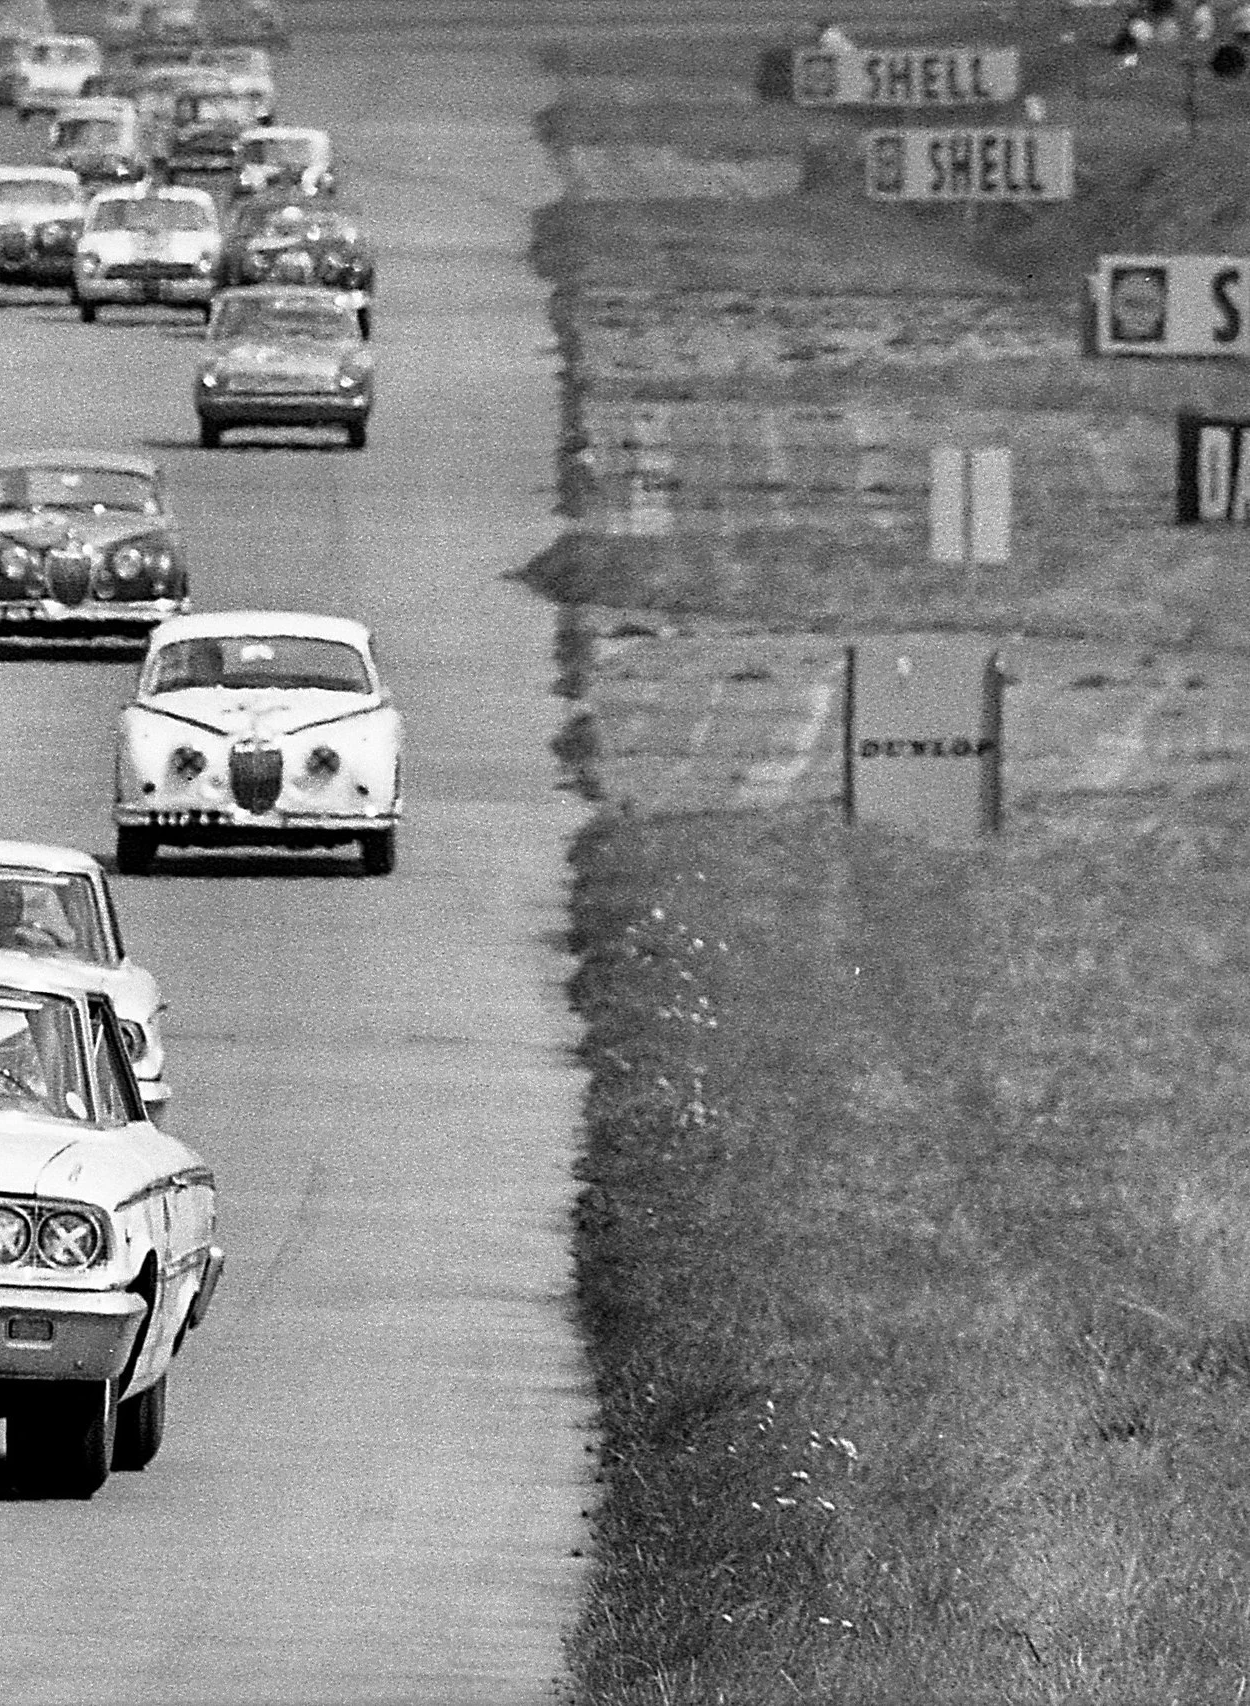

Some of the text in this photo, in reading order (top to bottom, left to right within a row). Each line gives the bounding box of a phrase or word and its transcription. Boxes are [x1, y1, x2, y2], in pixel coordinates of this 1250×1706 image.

[865, 56, 988, 99] SHELL
[930, 133, 1045, 193] SHELL
[1212, 267, 1241, 343] S
